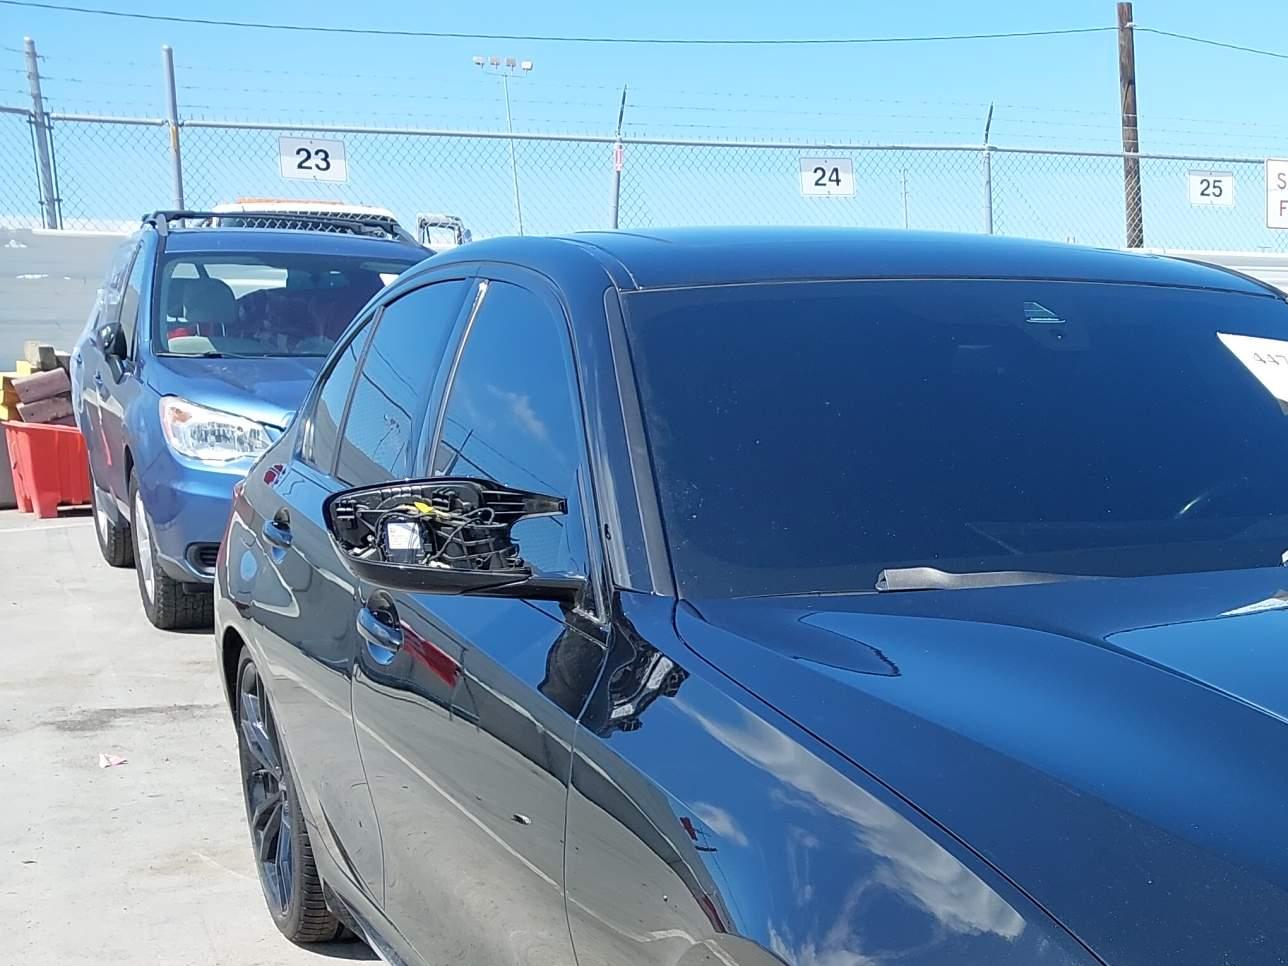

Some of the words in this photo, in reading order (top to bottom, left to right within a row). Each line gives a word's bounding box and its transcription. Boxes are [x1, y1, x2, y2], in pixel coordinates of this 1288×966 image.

[295, 147, 331, 171] 23
[813, 166, 842, 187] 24
[1199, 178, 1223, 198] 25
